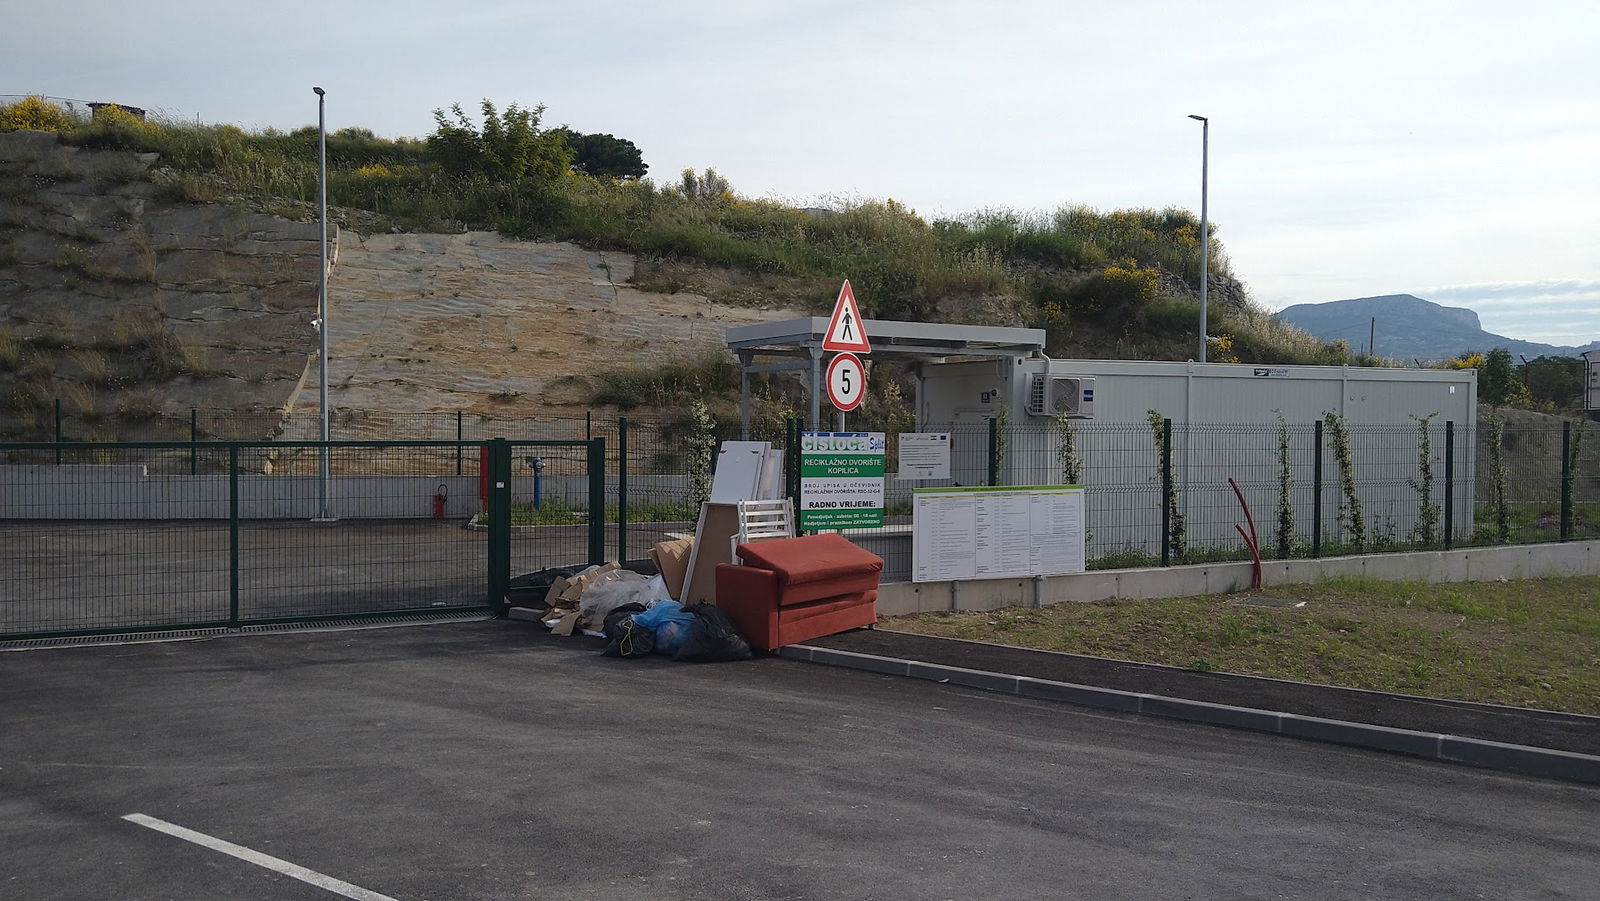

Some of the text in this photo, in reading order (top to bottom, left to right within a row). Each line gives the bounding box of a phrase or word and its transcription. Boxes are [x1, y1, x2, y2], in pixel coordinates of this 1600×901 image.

[842, 369, 851, 395] 5
[804, 457, 882, 466] RECIKLAŽNO DVORIŠTE
[839, 500, 876, 508] VRIJEME:
